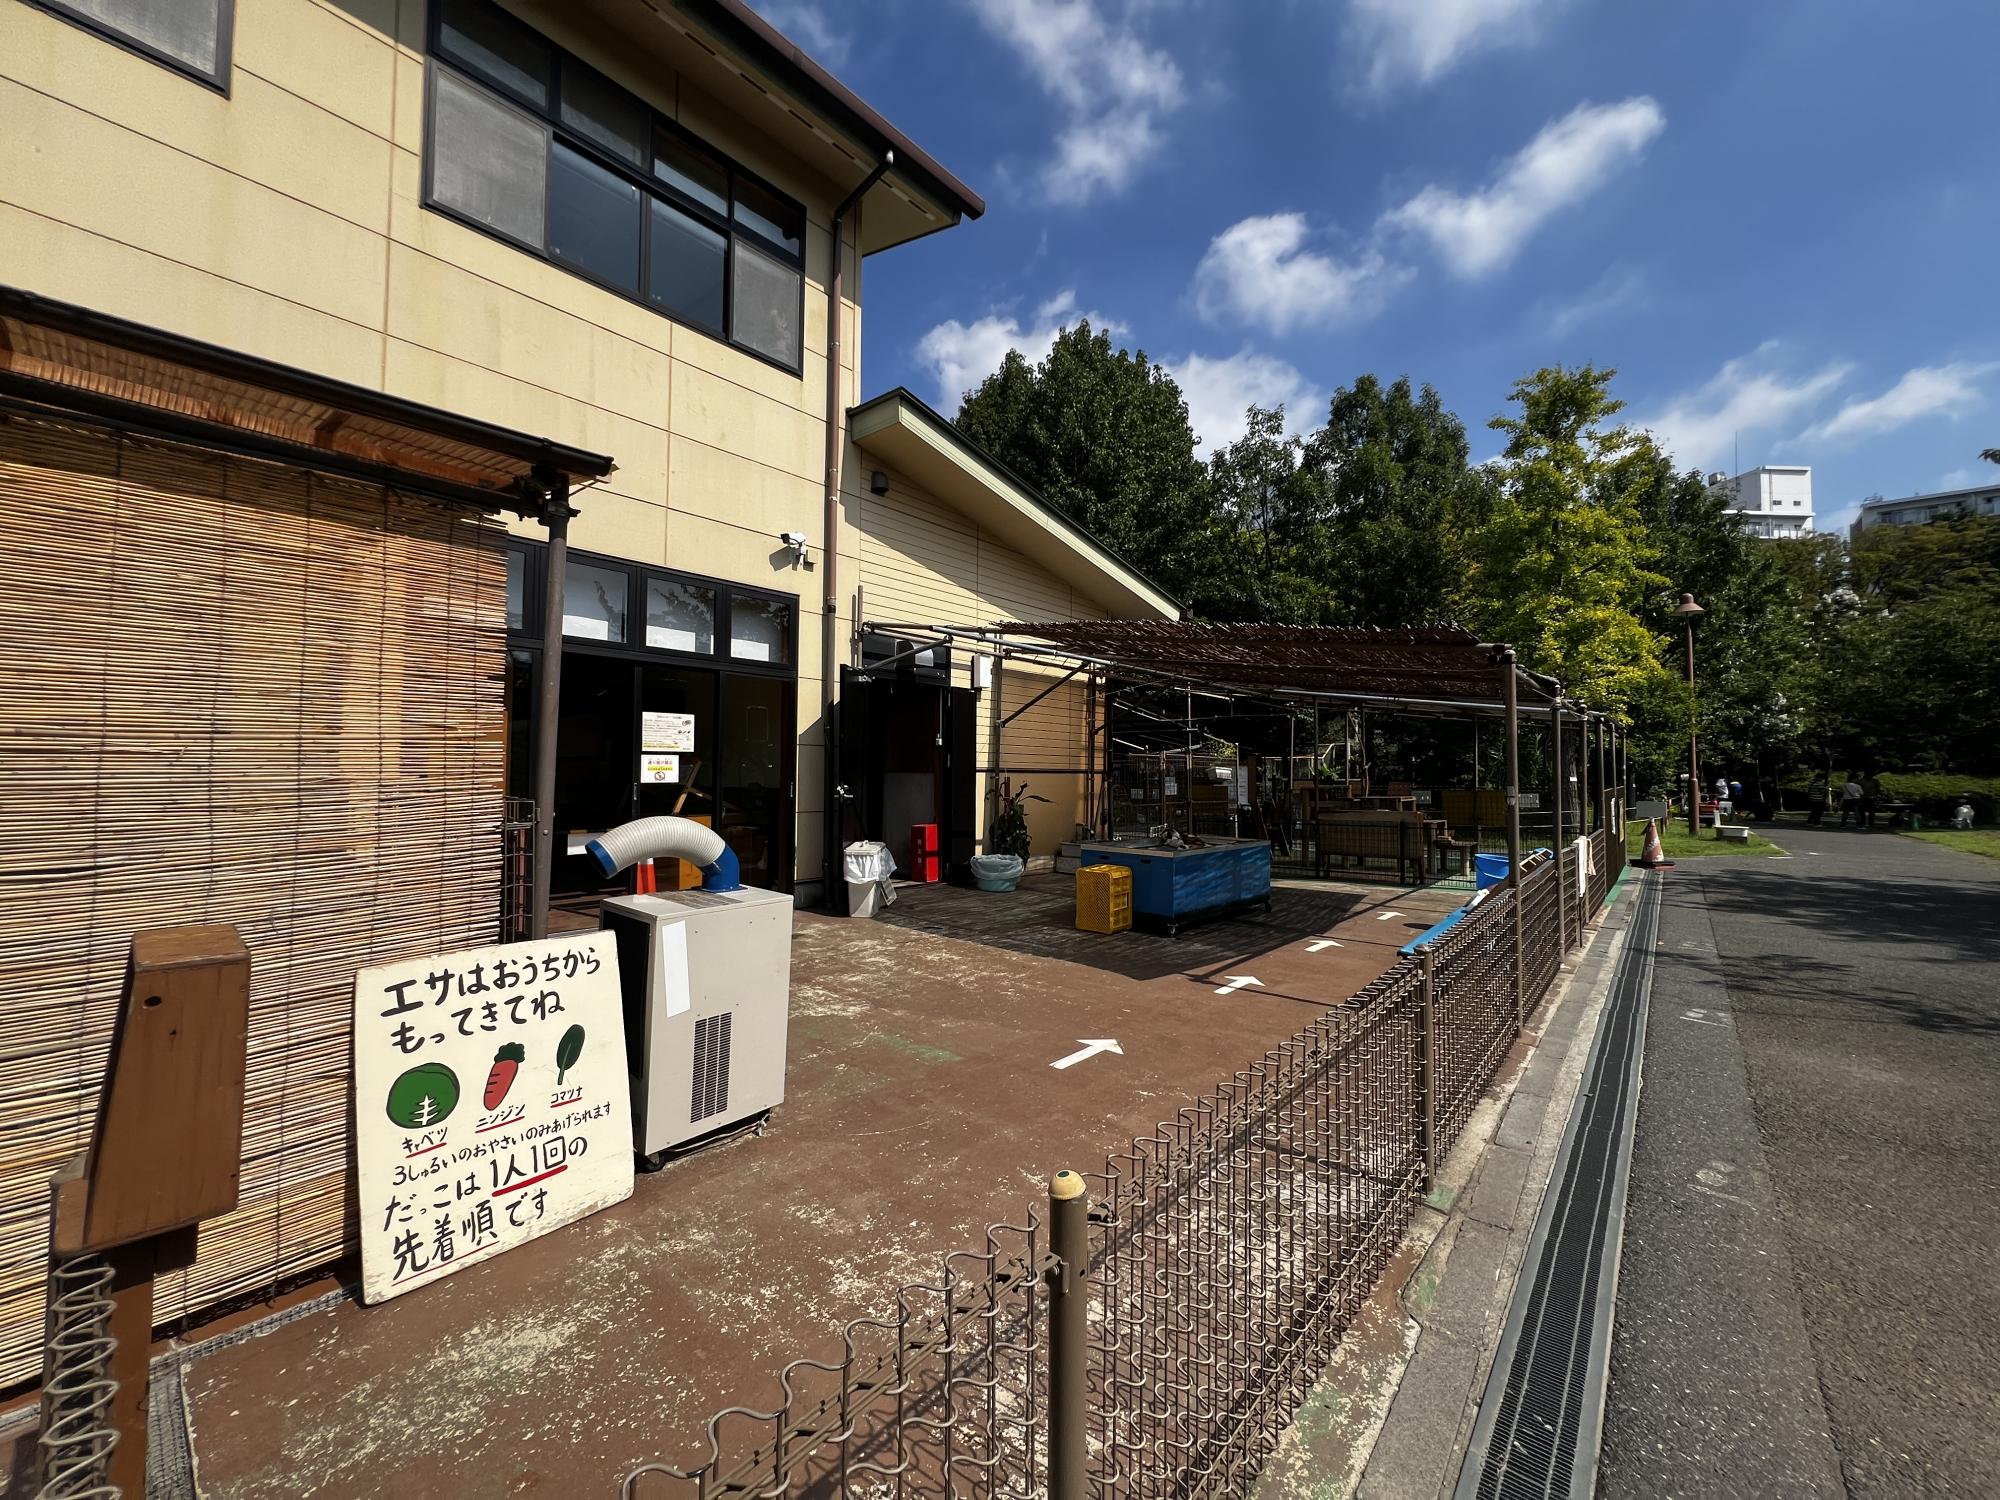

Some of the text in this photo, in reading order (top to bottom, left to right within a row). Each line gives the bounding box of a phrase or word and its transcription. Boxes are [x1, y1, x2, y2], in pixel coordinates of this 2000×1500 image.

[380, 946, 601, 1018] エサはおうちから
[390, 989, 566, 1055] もってきてね
[475, 1103, 526, 1128] ニンジン
[550, 1085, 584, 1105] コマツナ
[392, 1101, 611, 1186] 3しゅるいのおやさいのみあげられます
[401, 1126, 448, 1154] キャベツ
[392, 1187, 548, 1281] 先着順です
